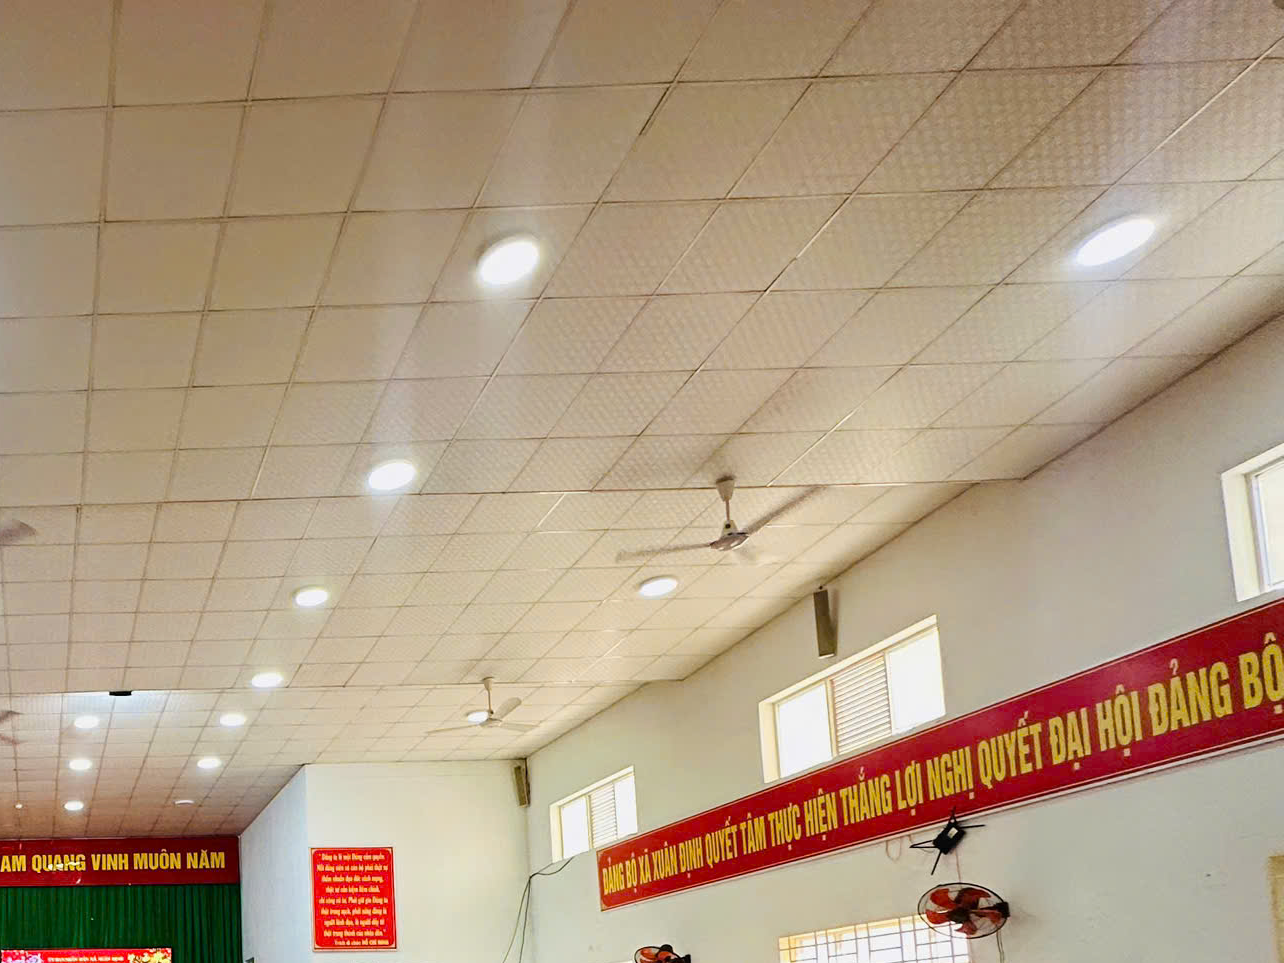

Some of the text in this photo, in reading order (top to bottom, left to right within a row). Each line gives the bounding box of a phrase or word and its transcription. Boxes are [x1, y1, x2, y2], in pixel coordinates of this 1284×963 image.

[602, 632, 1284, 895] ĐẢNG BỘ XÃ XUÂN ĐỊNH QUYẾT TÂM THỰC HIỆN THẮNG LỢI NGHỊ QUYẾT ĐẠI HỘI ĐẢNG BỘ
[32, 854, 86, 873] QUANG
[91, 853, 128, 870] VINH
[133, 849, 182, 870] MUÔN
[186, 850, 225, 868] NĂM
